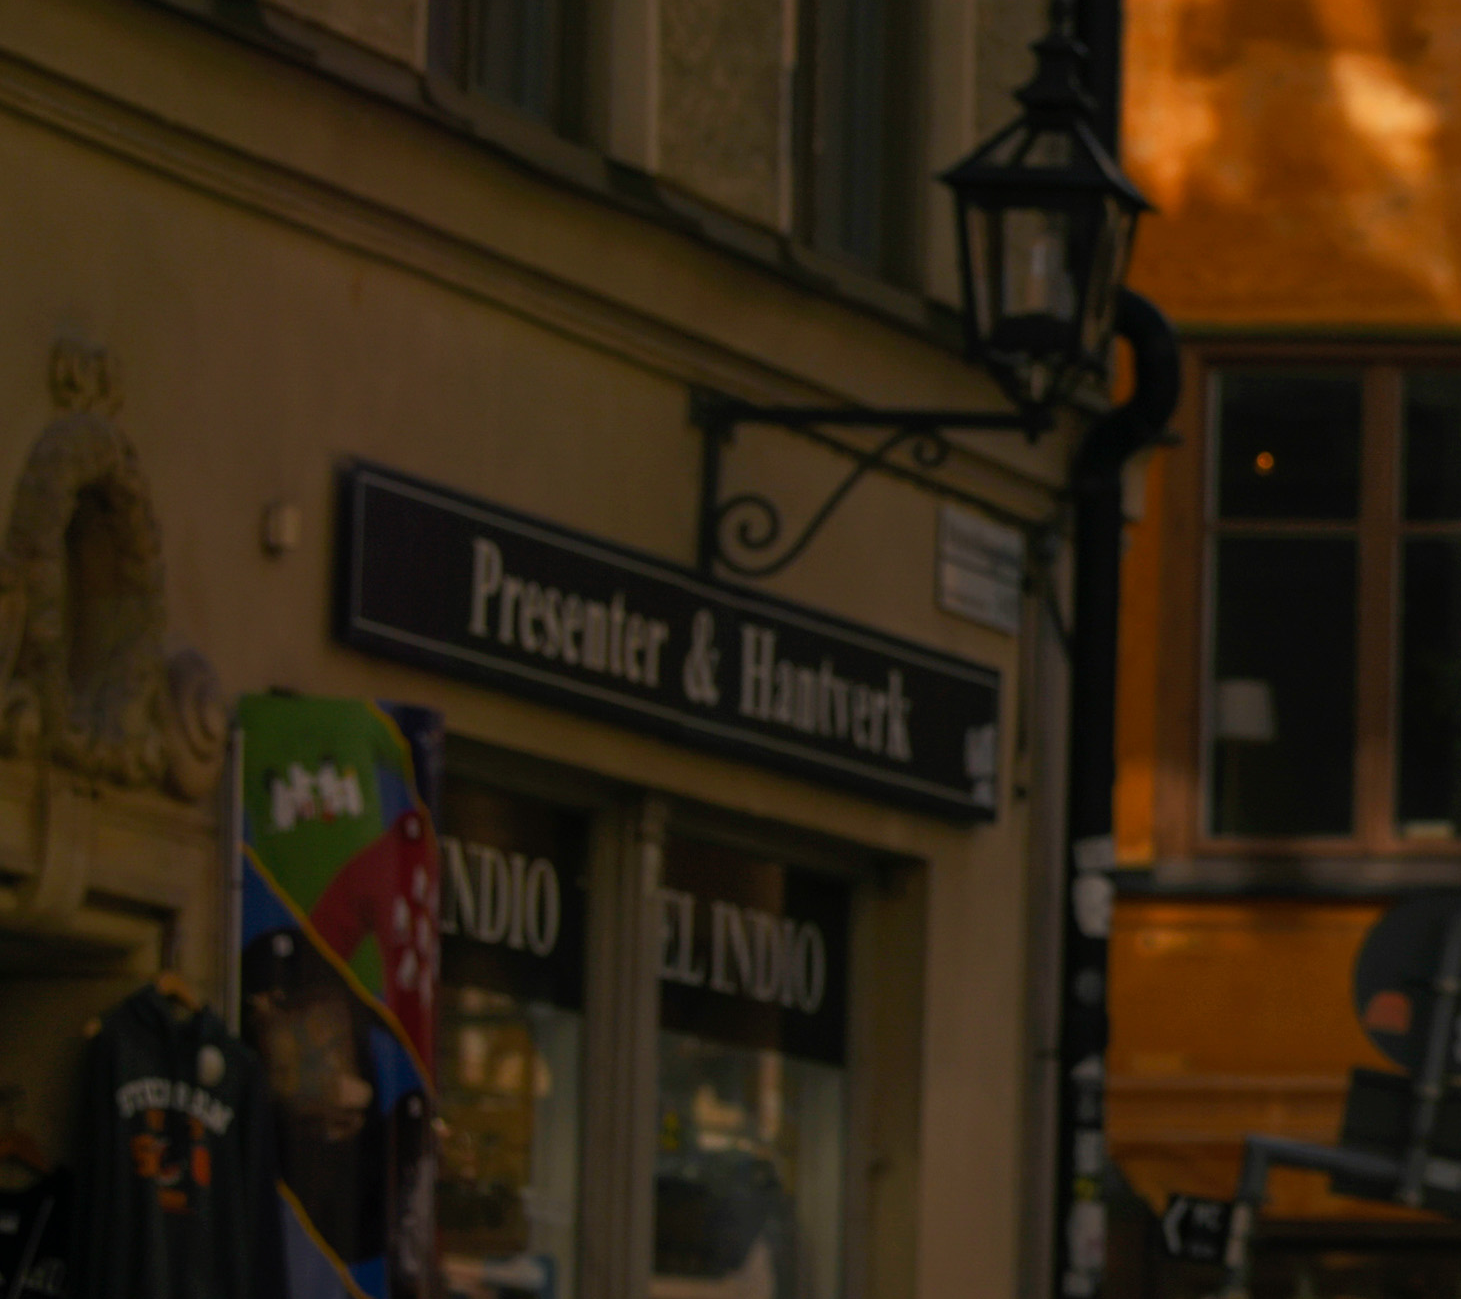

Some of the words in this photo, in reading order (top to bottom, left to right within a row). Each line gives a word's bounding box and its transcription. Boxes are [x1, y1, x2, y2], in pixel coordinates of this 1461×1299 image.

[467, 537, 671, 689] Presenter
[682, 607, 722, 707] &
[739, 623, 914, 764] Hantverk
[441, 834, 561, 958] NDIO
[709, 900, 827, 1016] INDIO
